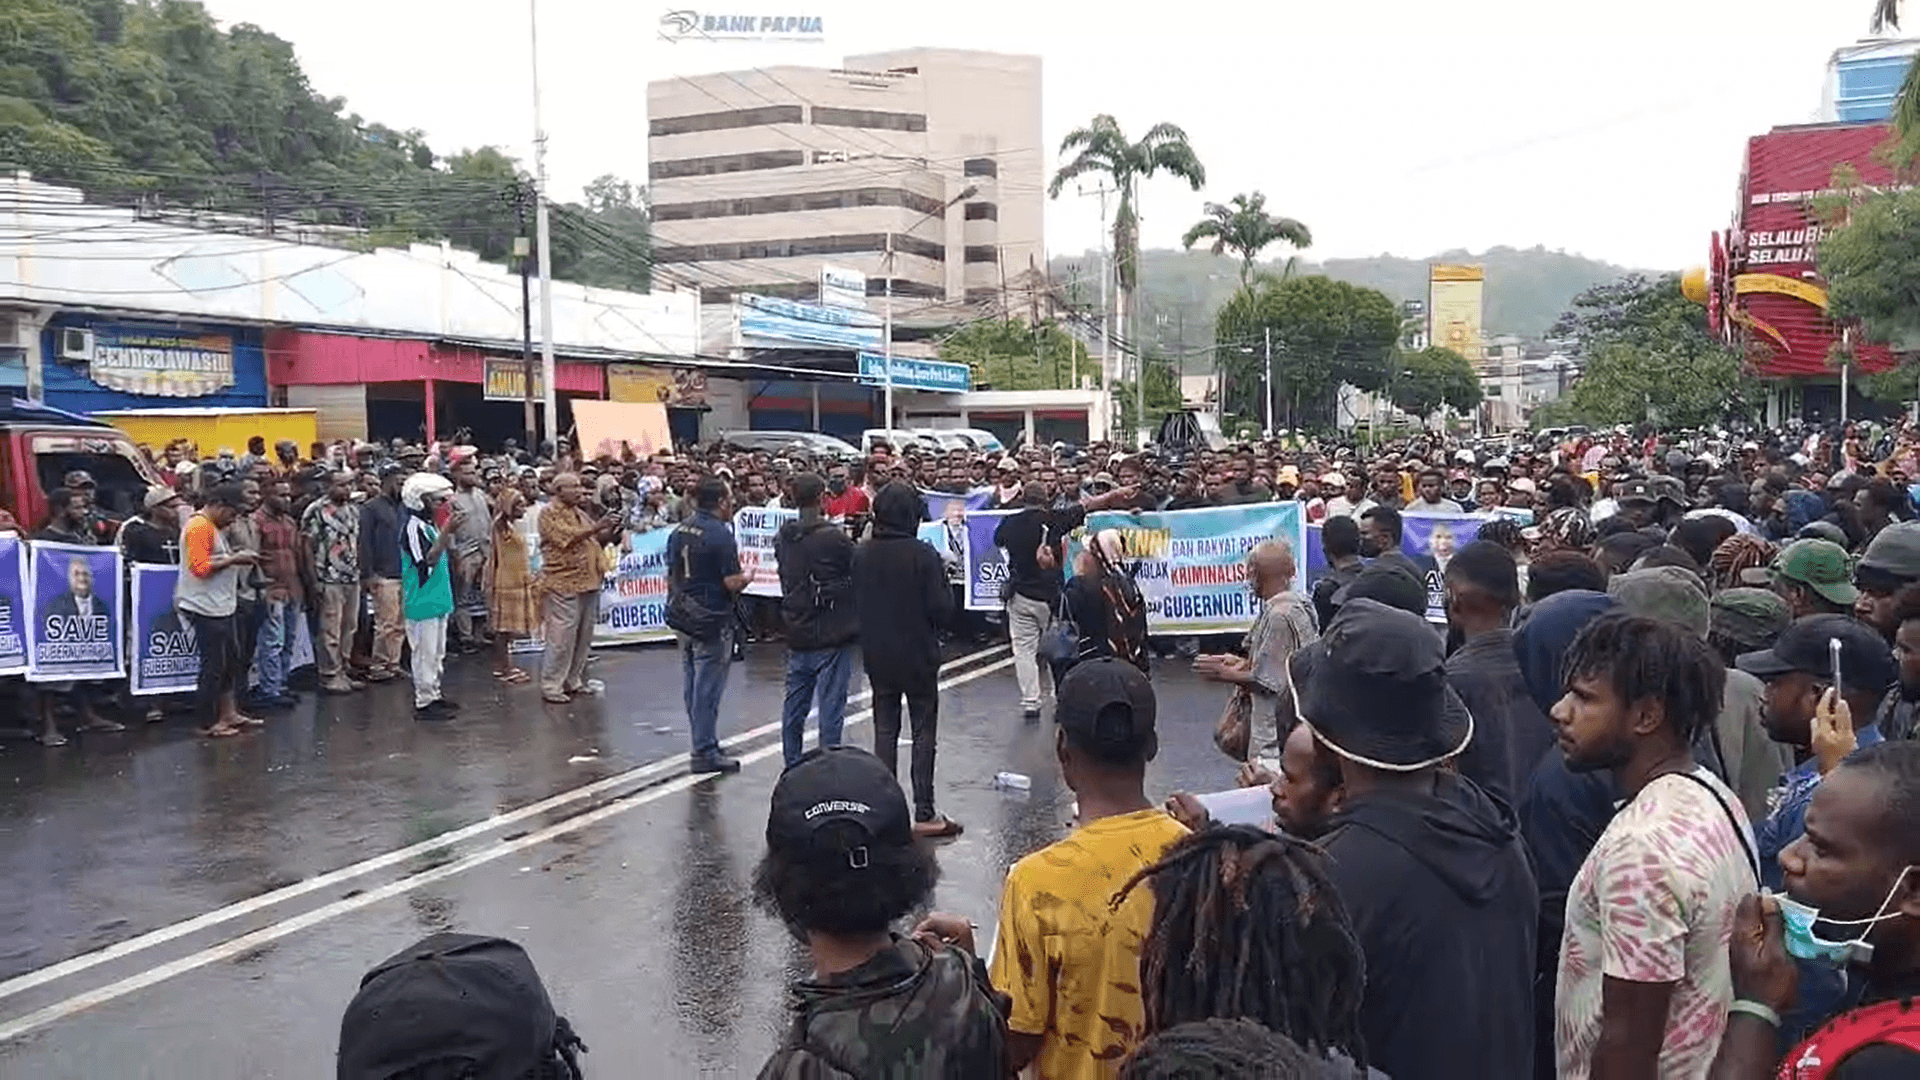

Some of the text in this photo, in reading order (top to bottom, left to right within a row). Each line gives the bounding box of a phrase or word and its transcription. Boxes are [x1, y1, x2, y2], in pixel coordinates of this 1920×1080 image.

[703, 15, 823, 33] BANK PAPUA
[1748, 230, 1805, 247] SELALU
[1748, 248, 1804, 264] SELALU
[741, 511, 769, 530] SAVE
[1172, 540, 1194, 558] DAN
[1197, 537, 1236, 556] RAKYAT
[1171, 563, 1249, 587] KRIMINALIS
[620, 578, 668, 597] KRIMIN
[1164, 593, 1243, 618] GUBERNUR
[612, 604, 667, 629] GUBERN
[45, 615, 108, 641] SAVE
[149, 631, 197, 656] SAV
